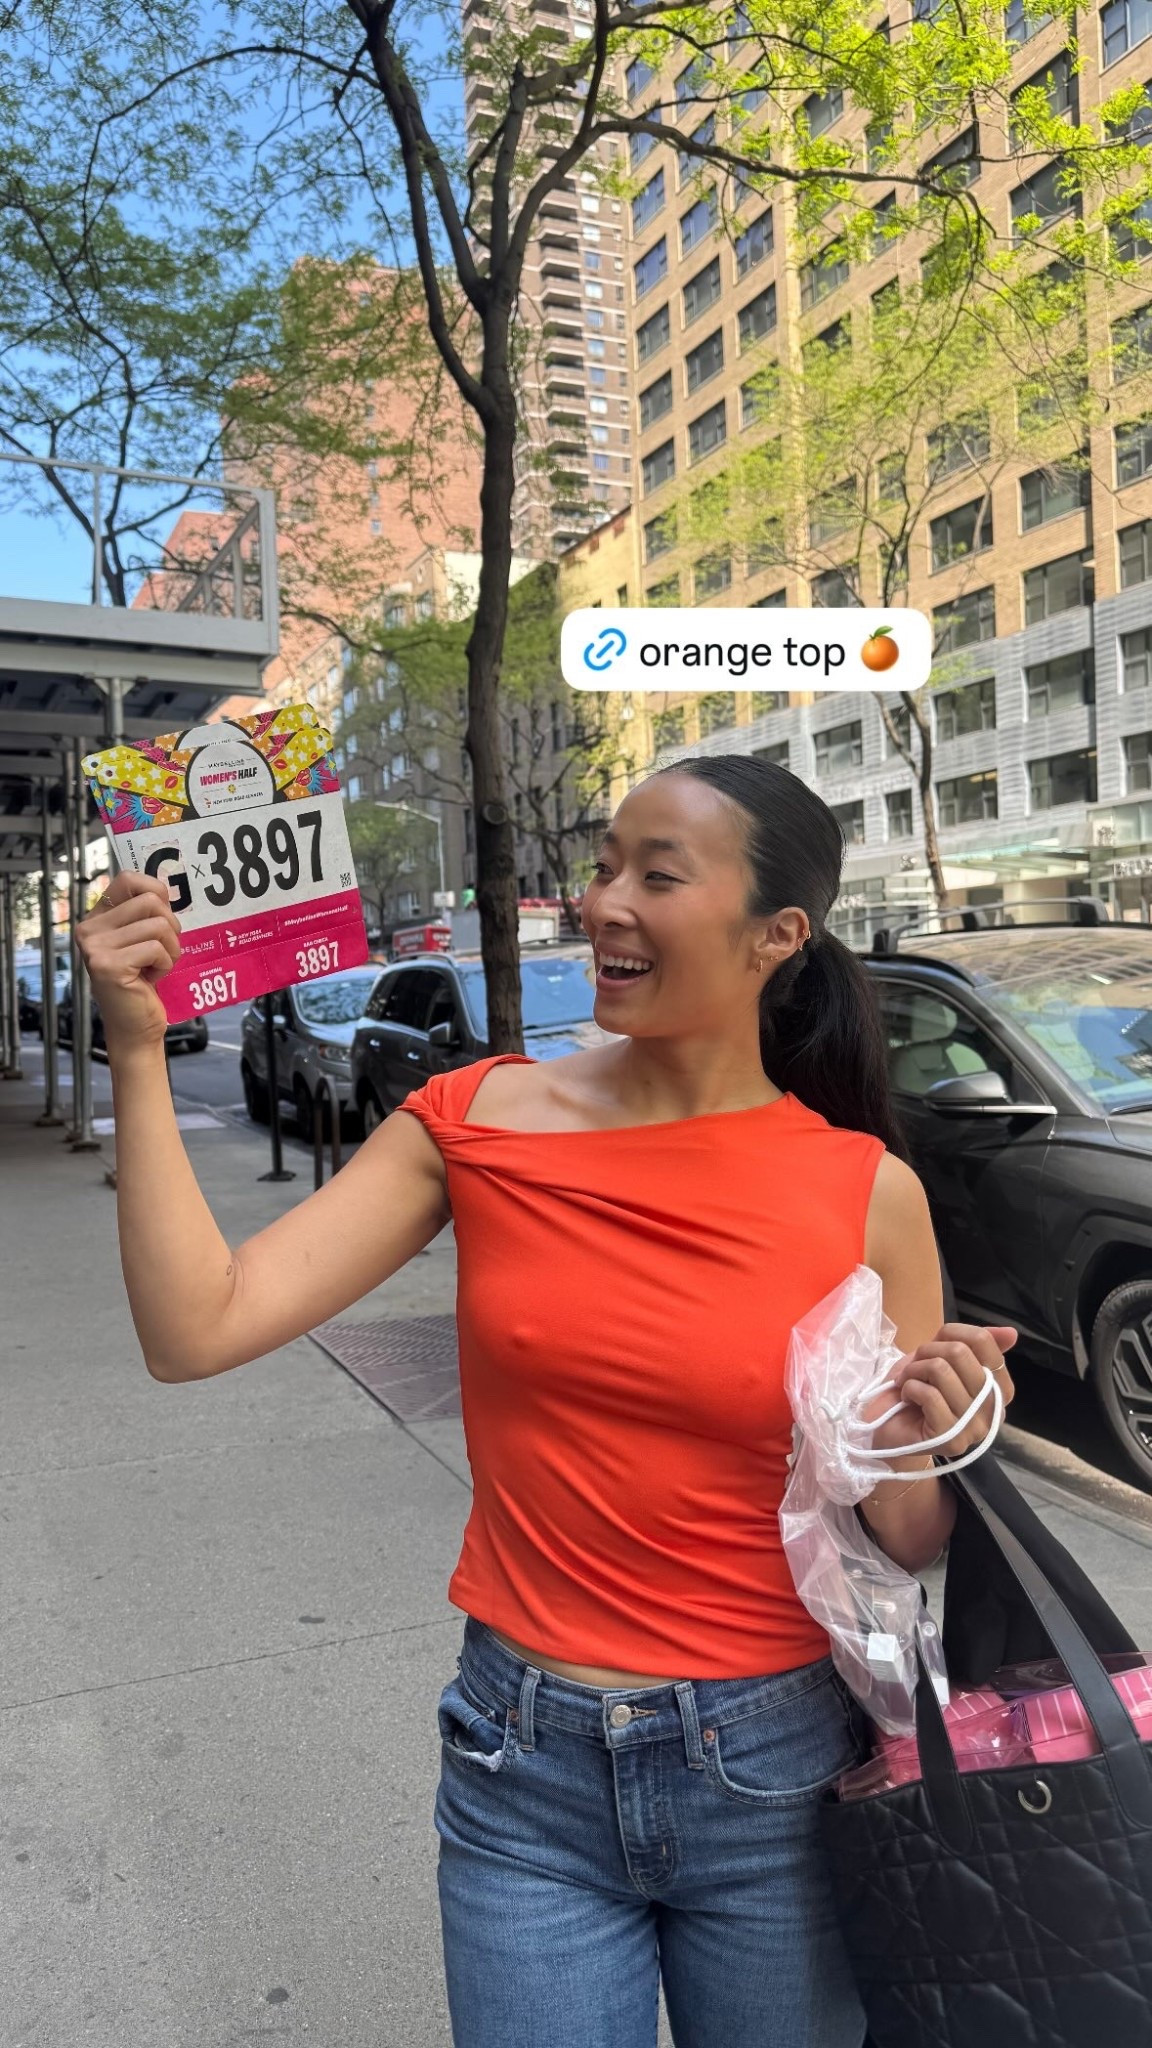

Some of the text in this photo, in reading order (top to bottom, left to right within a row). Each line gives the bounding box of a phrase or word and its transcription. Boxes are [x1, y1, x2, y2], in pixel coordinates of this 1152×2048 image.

[200, 766, 258, 787] WOMEN'S HALF
[197, 810, 324, 907] 3897
[180, 939, 215, 955] BELLINE
[295, 941, 340, 978] 3897
[188, 971, 238, 1011] 3897
